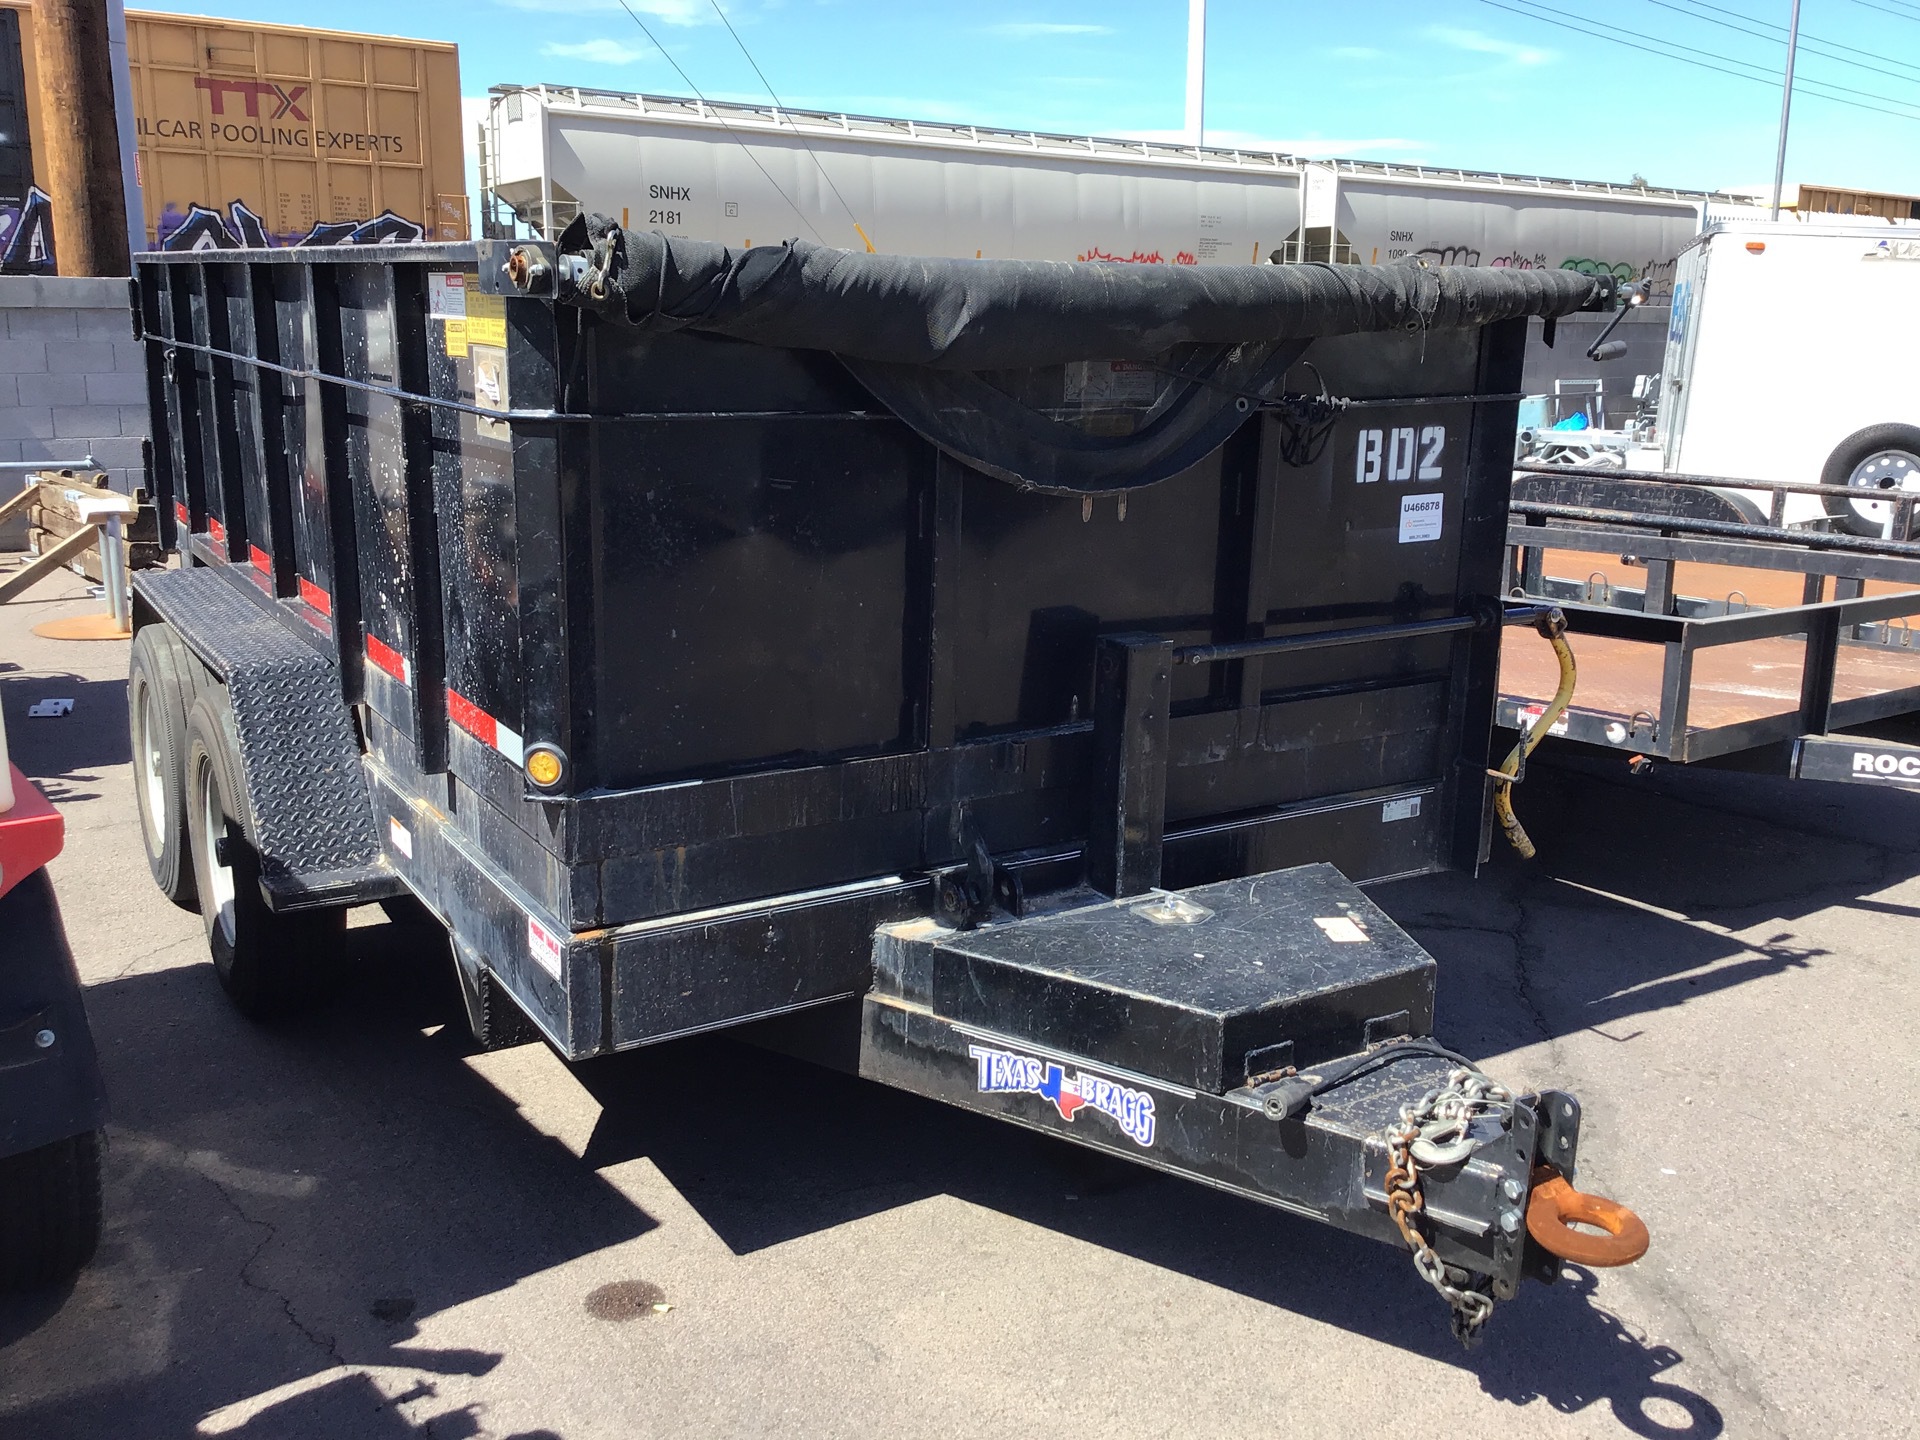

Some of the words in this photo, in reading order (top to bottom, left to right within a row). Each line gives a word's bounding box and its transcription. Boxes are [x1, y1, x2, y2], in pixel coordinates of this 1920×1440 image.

[194, 77, 310, 121] TTX
[137, 117, 203, 139] ILCAR
[211, 122, 308, 147] POOLING
[316, 130, 404, 153] EXPERTS
[649, 184, 691, 201] SNHX
[649, 209, 681, 225] 2181
[1390, 230, 1414, 242] SNHX
[1403, 501, 1440, 513] U466878
[969, 1045, 1042, 1092] TEXAS
[1077, 1072, 1156, 1147] BRAGG
